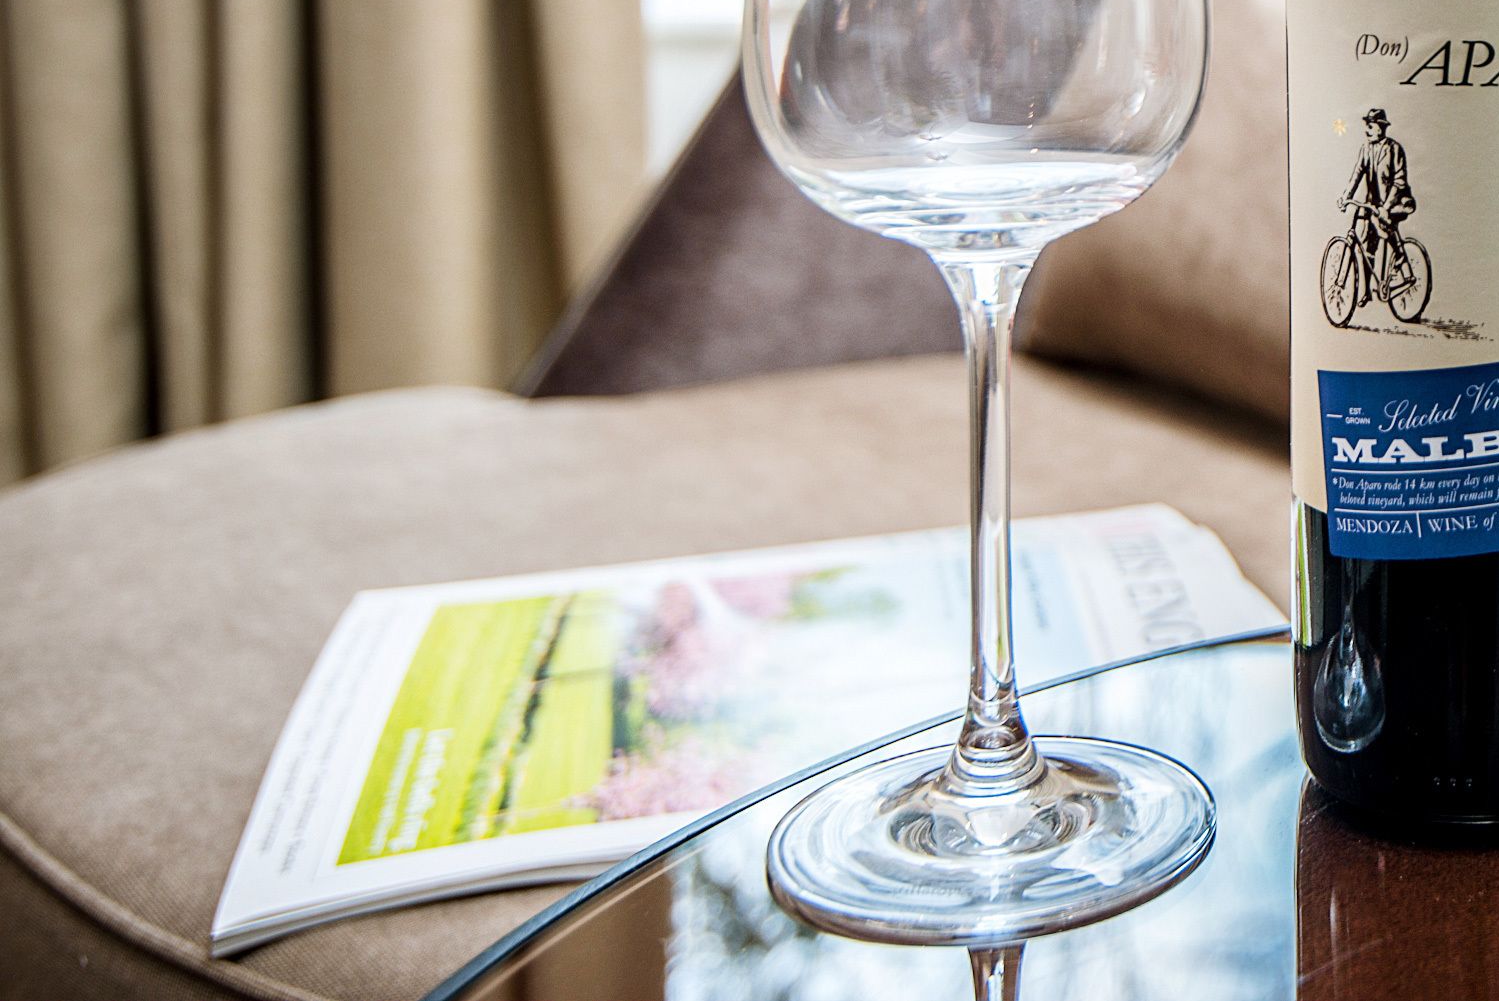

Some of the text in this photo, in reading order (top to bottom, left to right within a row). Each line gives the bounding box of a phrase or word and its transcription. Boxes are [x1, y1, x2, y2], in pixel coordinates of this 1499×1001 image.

[1355, 33, 1409, 64] (Don)
[1345, 416, 1371, 425] GROWN
[1378, 393, 1462, 433] Selected
[1356, 478, 1382, 493] Aparo
[1384, 478, 1402, 490] rode
[1405, 478, 1416, 490] 14
[1420, 478, 1436, 489] km
[1438, 478, 1461, 490] every
[1464, 473, 1480, 488] day
[1483, 474, 1495, 484] on
[1340, 491, 1366, 505] beloved
[1367, 493, 1406, 509] vineyard,
[1408, 492, 1435, 505] which
[1438, 488, 1457, 504] will
[1460, 487, 1494, 502] remain
[1336, 517, 1413, 534] MENDOZA
[1428, 514, 1478, 532] WINE
[1483, 511, 1497, 532] of
